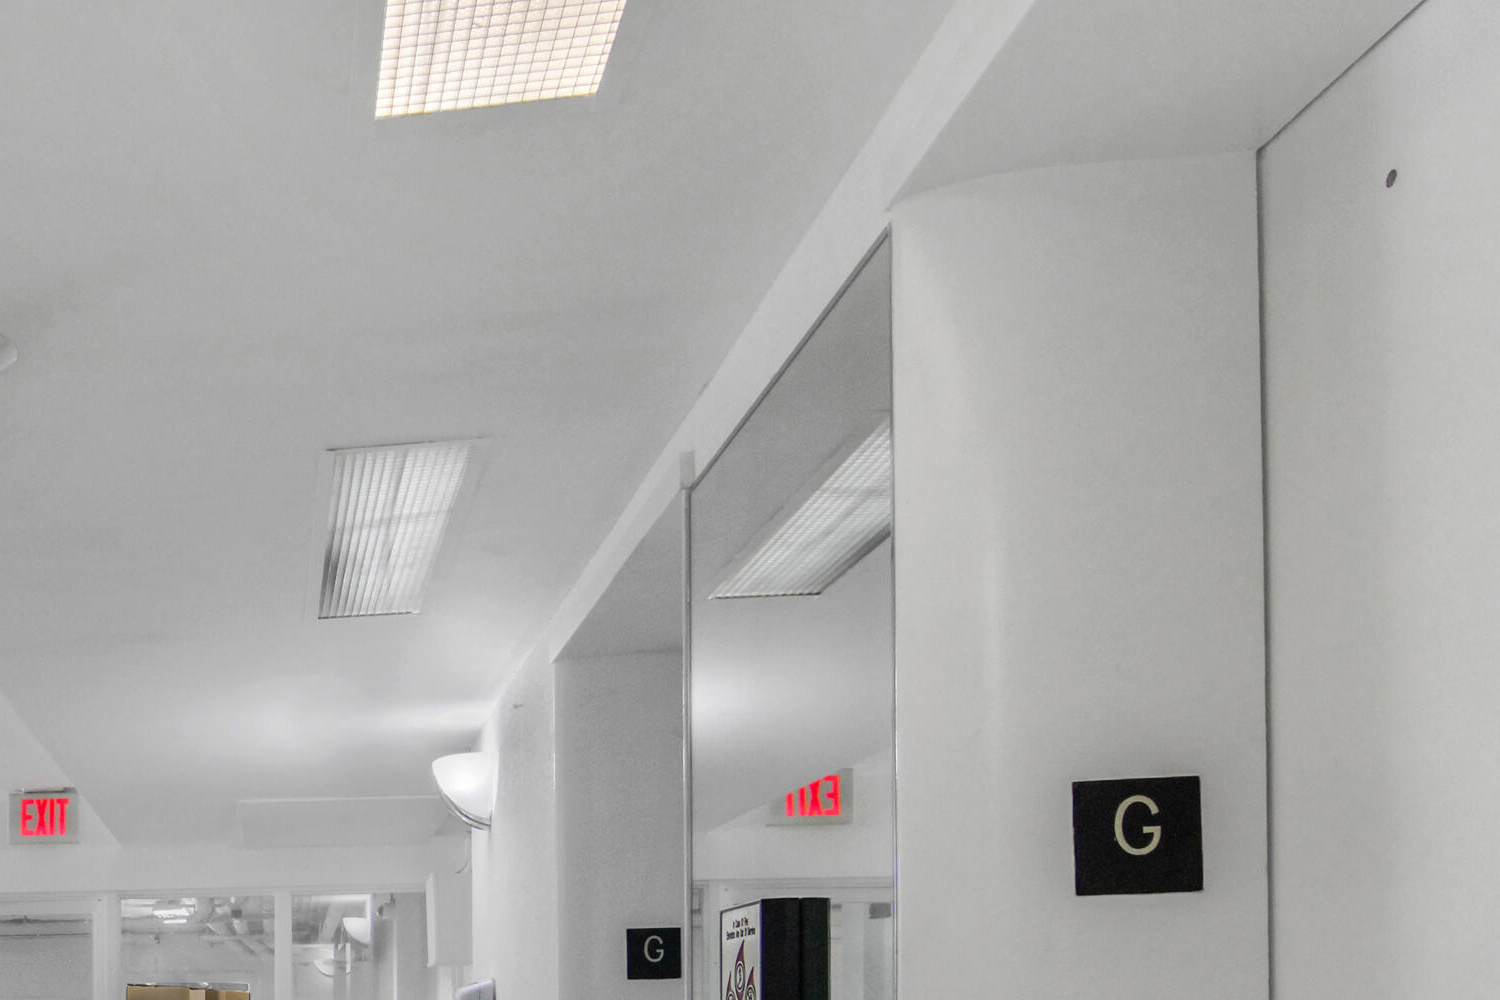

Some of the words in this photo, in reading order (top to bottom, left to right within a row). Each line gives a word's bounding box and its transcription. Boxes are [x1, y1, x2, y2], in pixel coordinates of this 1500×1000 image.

[20, 798, 70, 837] EXIT
[1114, 795, 1162, 856] G
[644, 935, 665, 963] G
